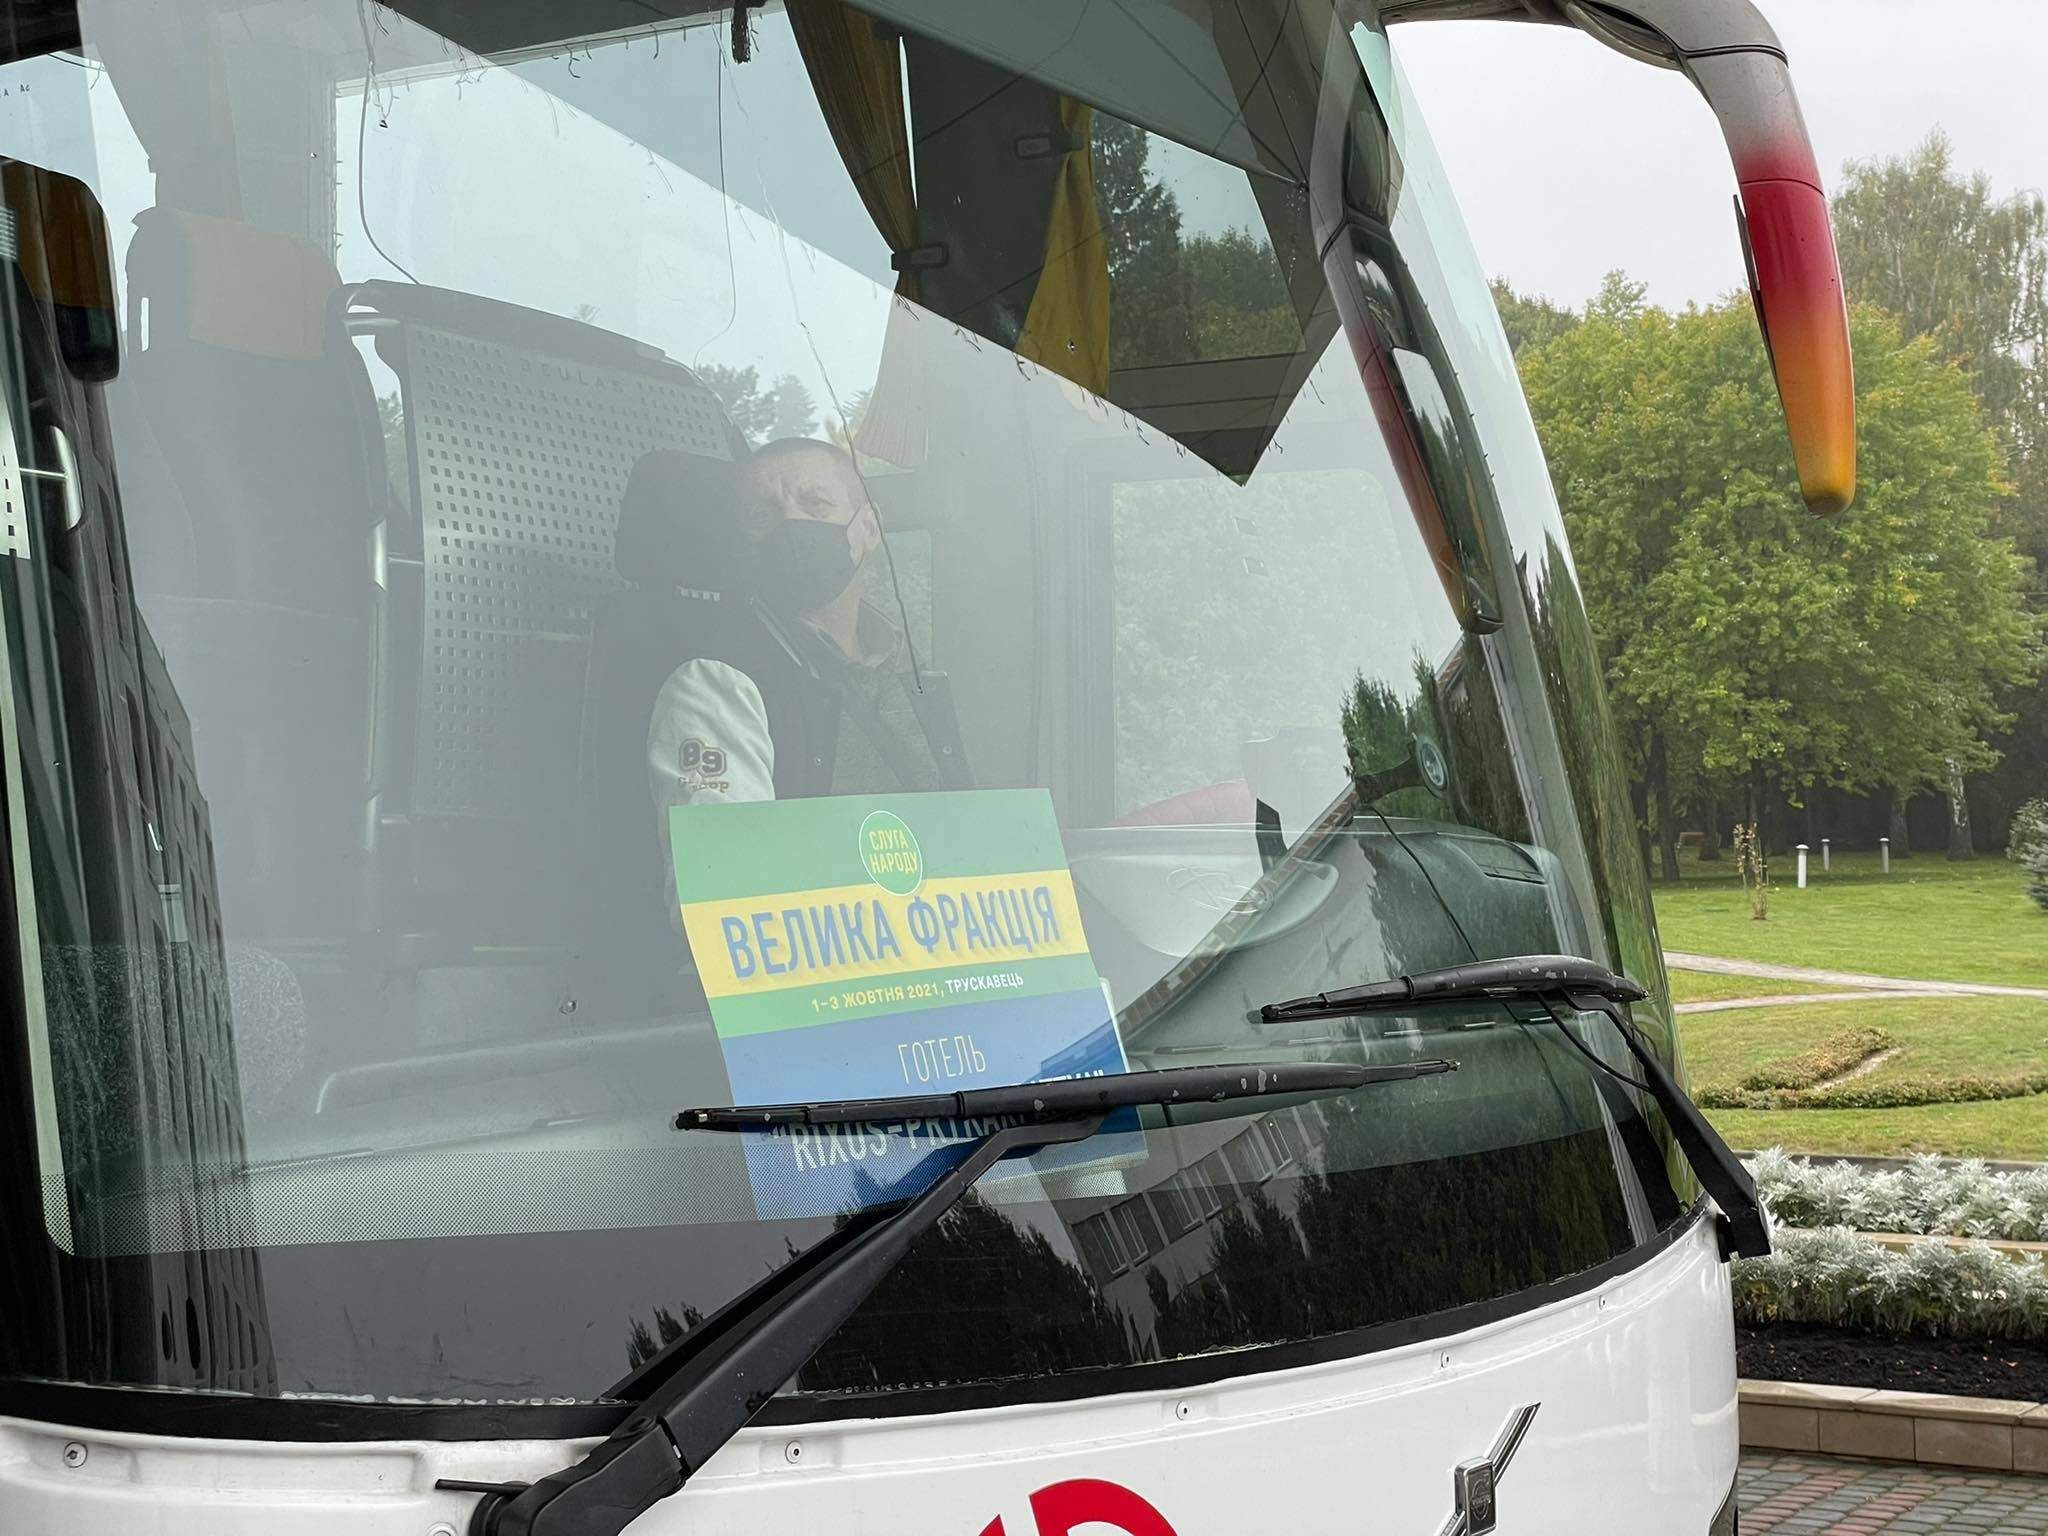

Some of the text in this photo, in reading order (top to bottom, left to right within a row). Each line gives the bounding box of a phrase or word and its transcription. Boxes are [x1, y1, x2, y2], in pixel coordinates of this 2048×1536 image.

[868, 829, 909, 850] СЛУГА
[868, 851, 918, 875] НАРОДУ
[720, 886, 1062, 980] ВЕЛИКА ФРАКЦІЯ
[842, 987, 905, 1009] ЖОВТНЯ
[907, 983, 945, 999] 2021,
[944, 971, 1025, 995] ТРУСКАВЕЦЬ
[897, 1033, 987, 1085] ГОТЕЛЬ
